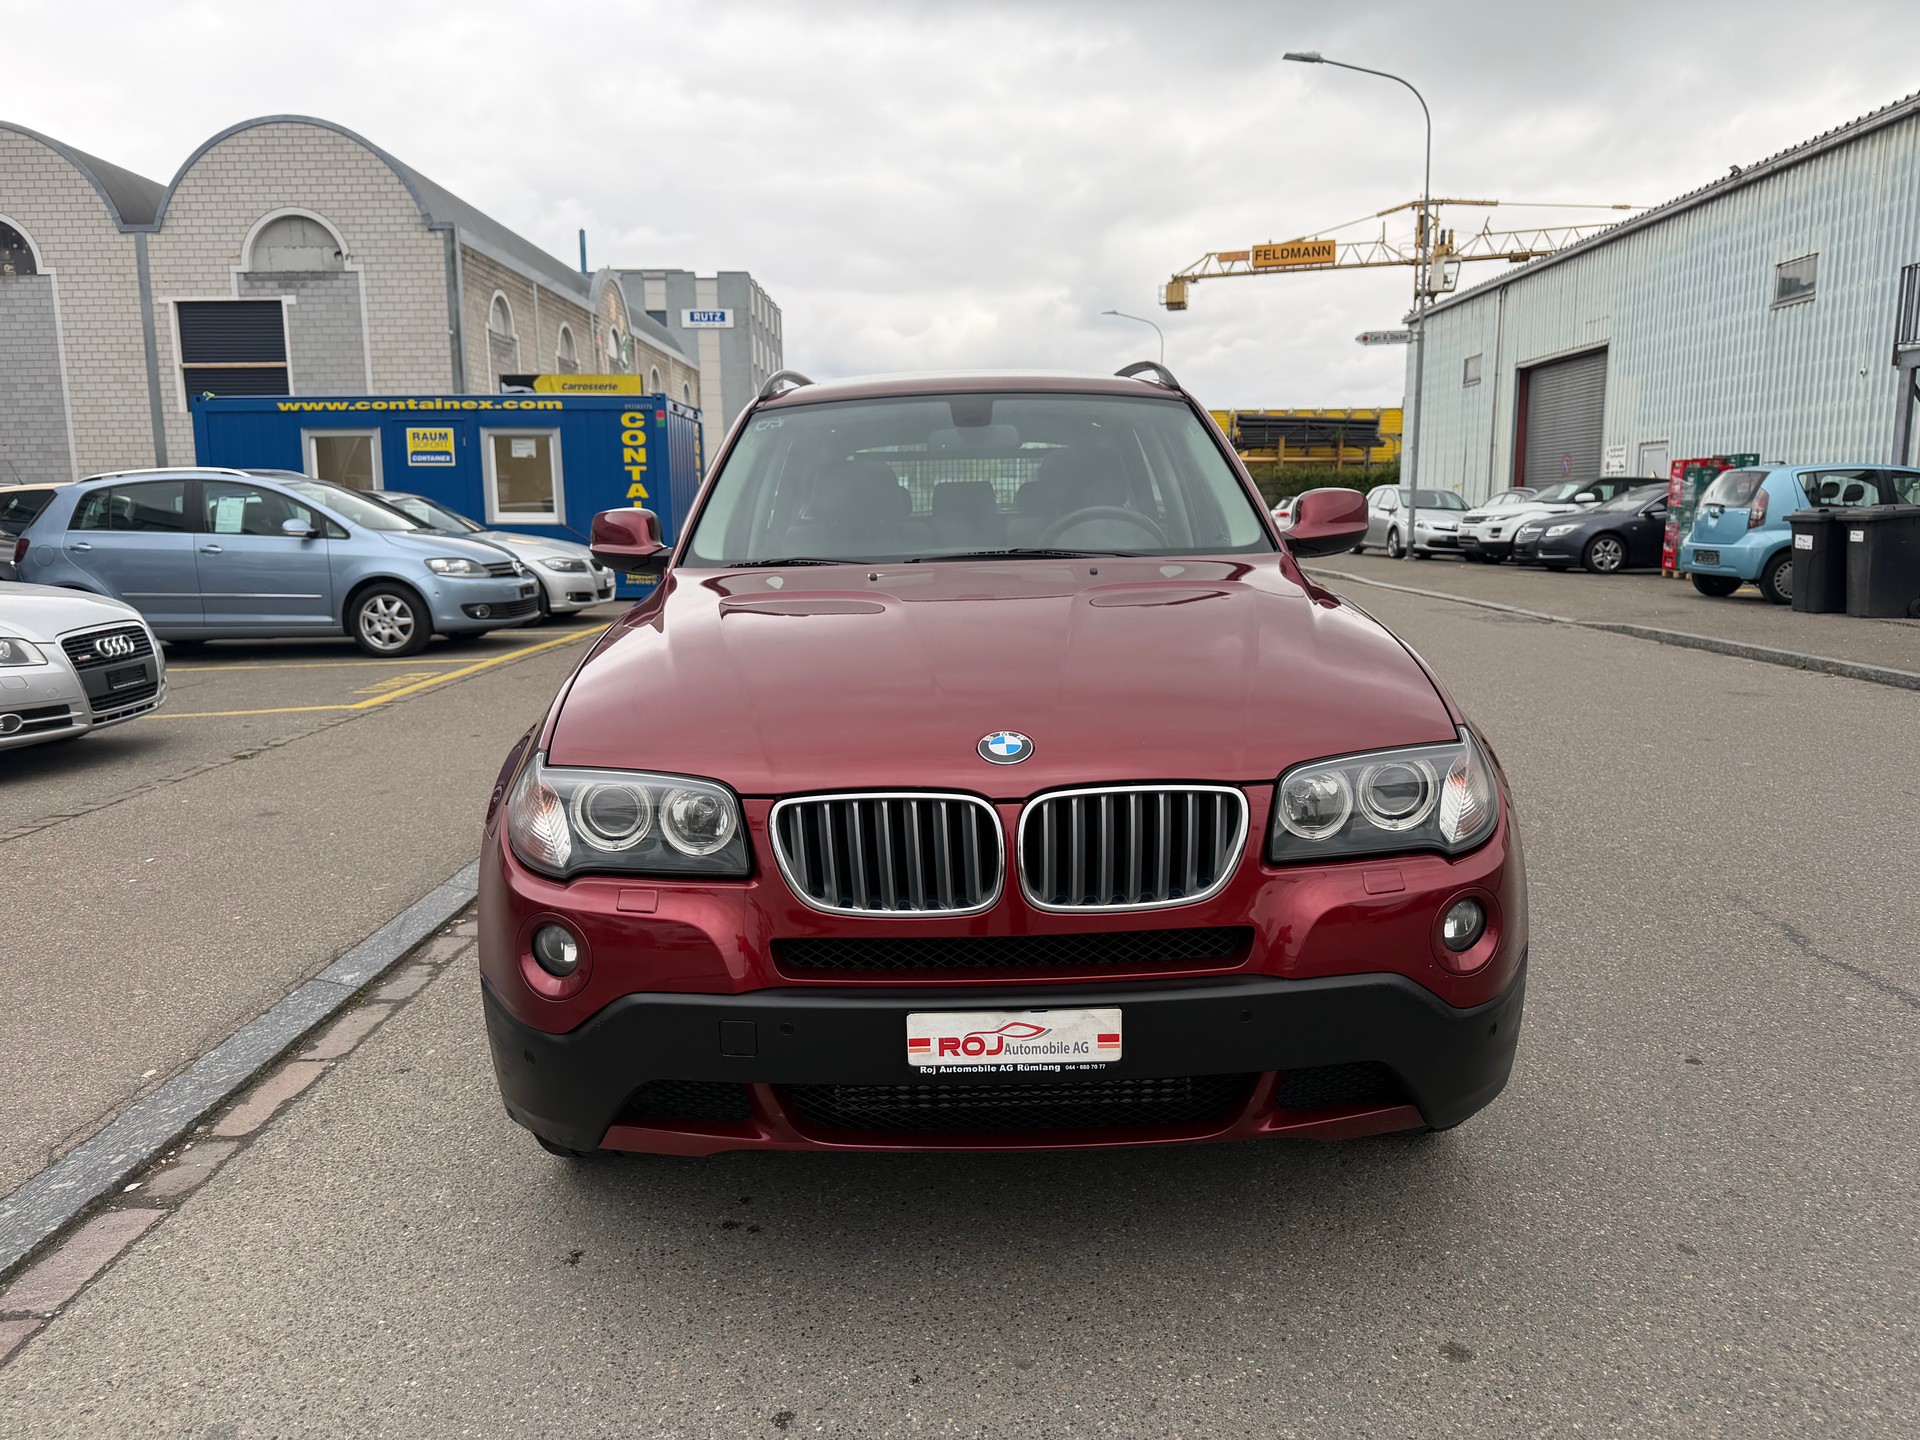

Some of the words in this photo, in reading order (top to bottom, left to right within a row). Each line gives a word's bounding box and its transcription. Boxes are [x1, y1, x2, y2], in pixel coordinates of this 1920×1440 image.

[1255, 245, 1331, 261] FELDMANN
[693, 312, 721, 321] RUTZ
[561, 382, 618, 391] Carrosserie
[277, 398, 563, 412] www.containex.com
[412, 432, 448, 441] RAUM
[938, 1036, 1004, 1057] ROJ
[1004, 1042, 1071, 1056] Automobile
[1073, 1041, 1090, 1054] AG
[919, 1065, 937, 1075] Roj
[939, 1064, 998, 1074] Automobile
[999, 1064, 1014, 1072] AG
[1017, 1063, 1062, 1074] Rümlang
